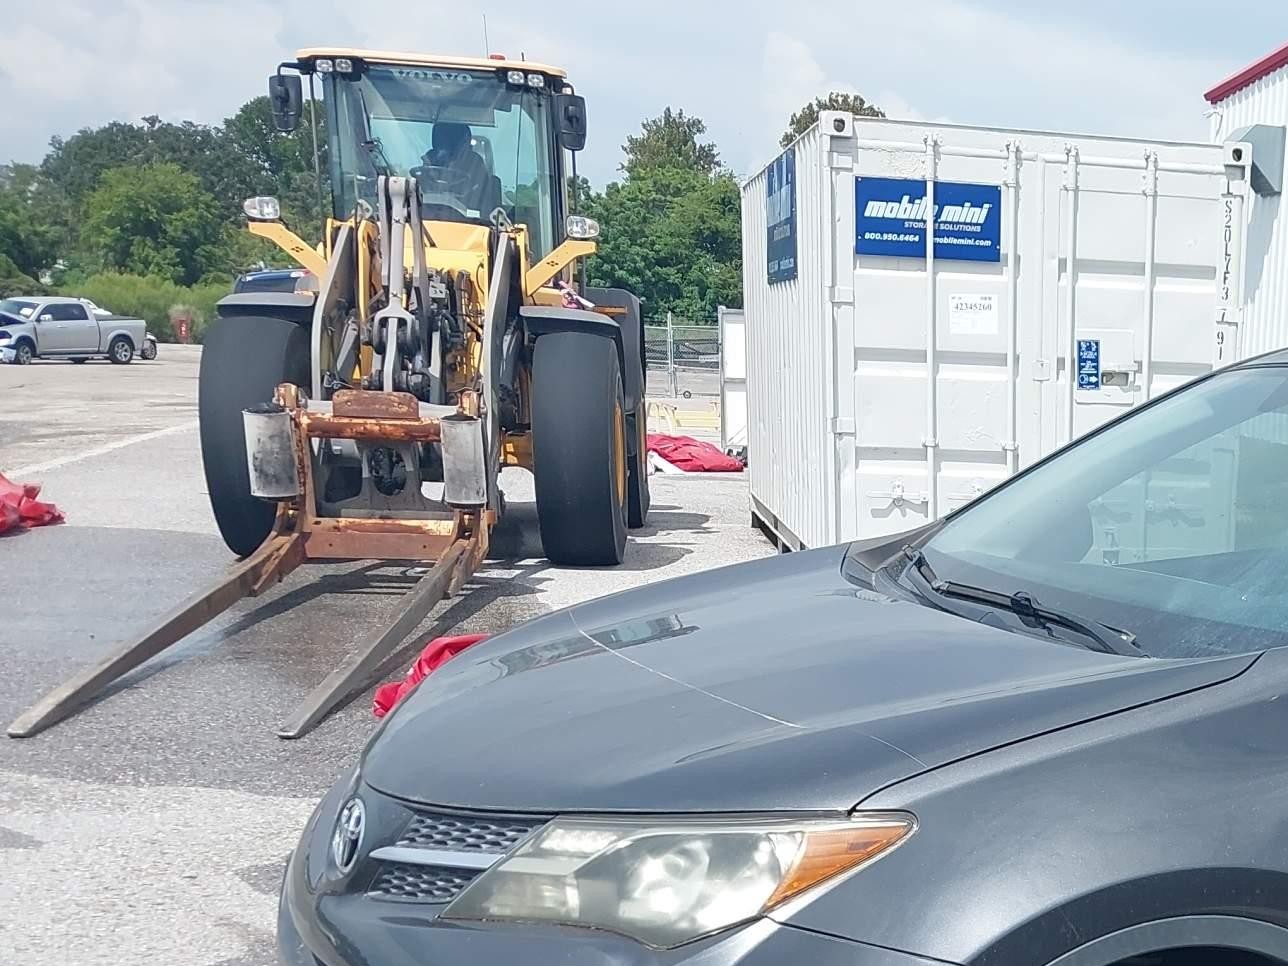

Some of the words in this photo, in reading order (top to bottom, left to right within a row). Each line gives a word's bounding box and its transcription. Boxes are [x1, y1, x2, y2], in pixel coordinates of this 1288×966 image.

[938, 202, 990, 224] mini
[939, 223, 982, 233] SOLUTIONS
[864, 232, 920, 242] 800.950.6464
